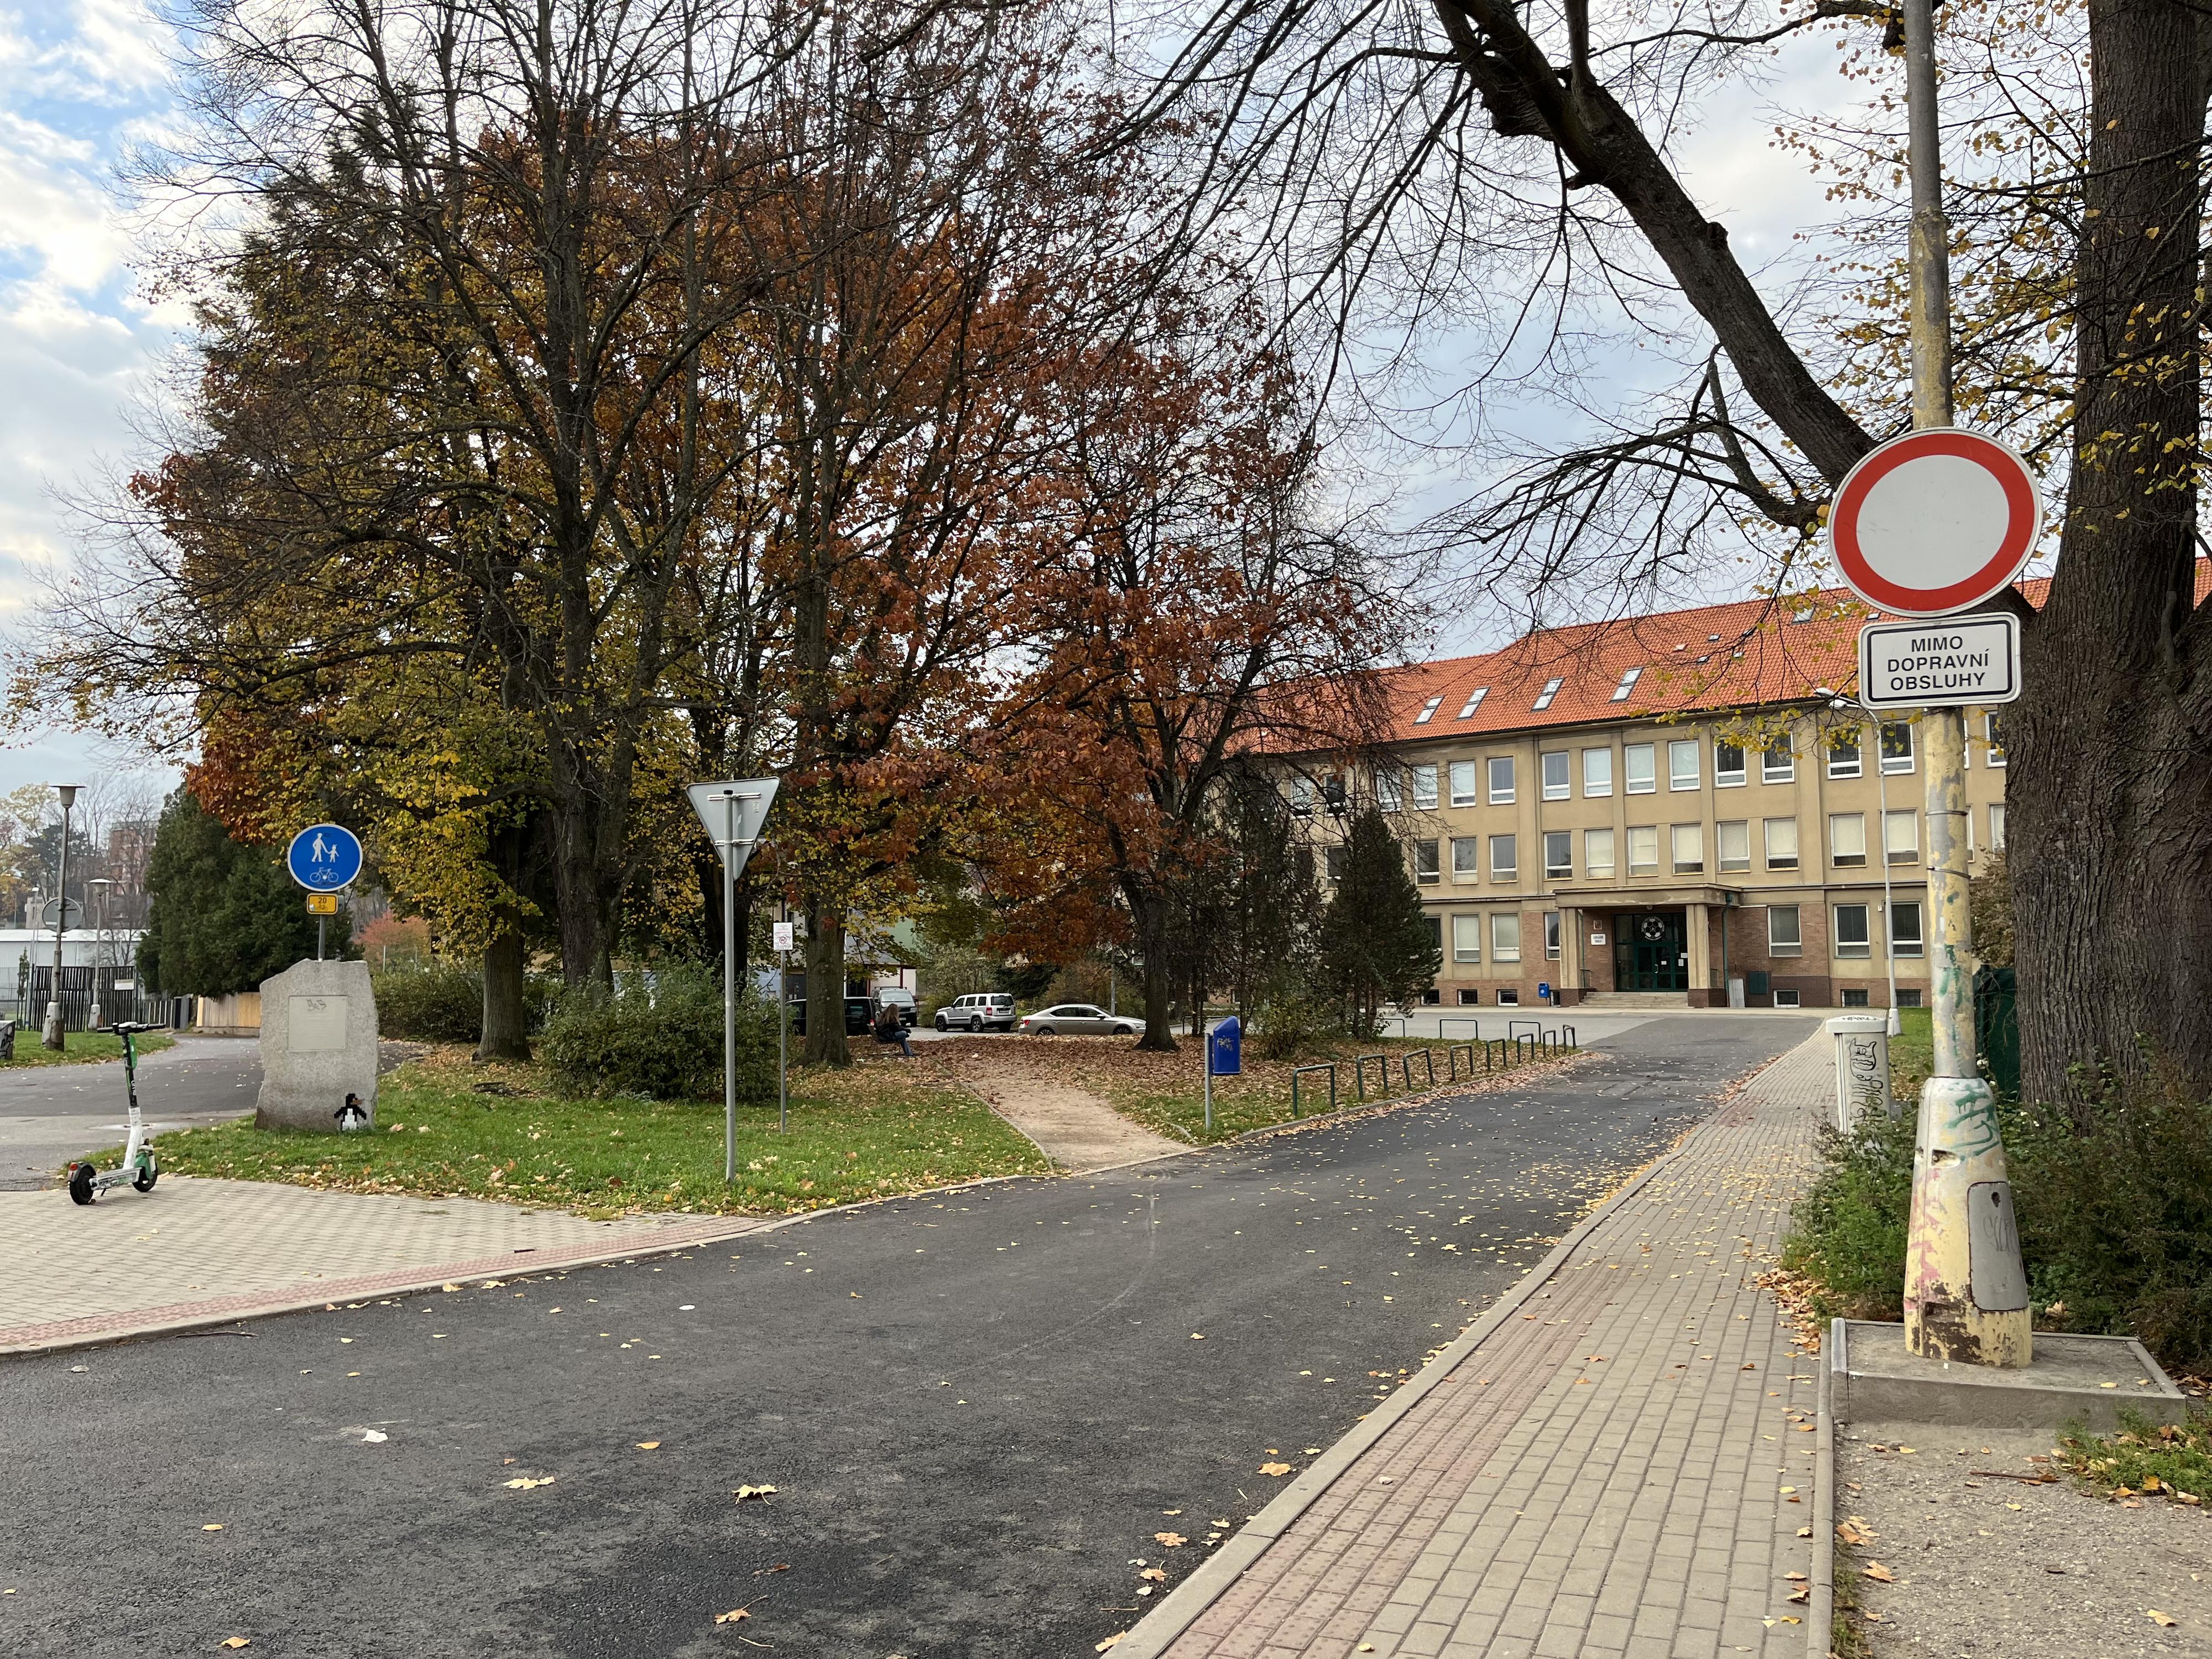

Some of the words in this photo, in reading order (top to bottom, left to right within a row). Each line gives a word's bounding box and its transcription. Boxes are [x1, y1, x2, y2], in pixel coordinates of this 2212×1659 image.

[1911, 636, 1963, 653] MIMO
[1887, 648, 1990, 672] DOPRAVNÍ
[1890, 672, 1986, 691] OBSLUHY
